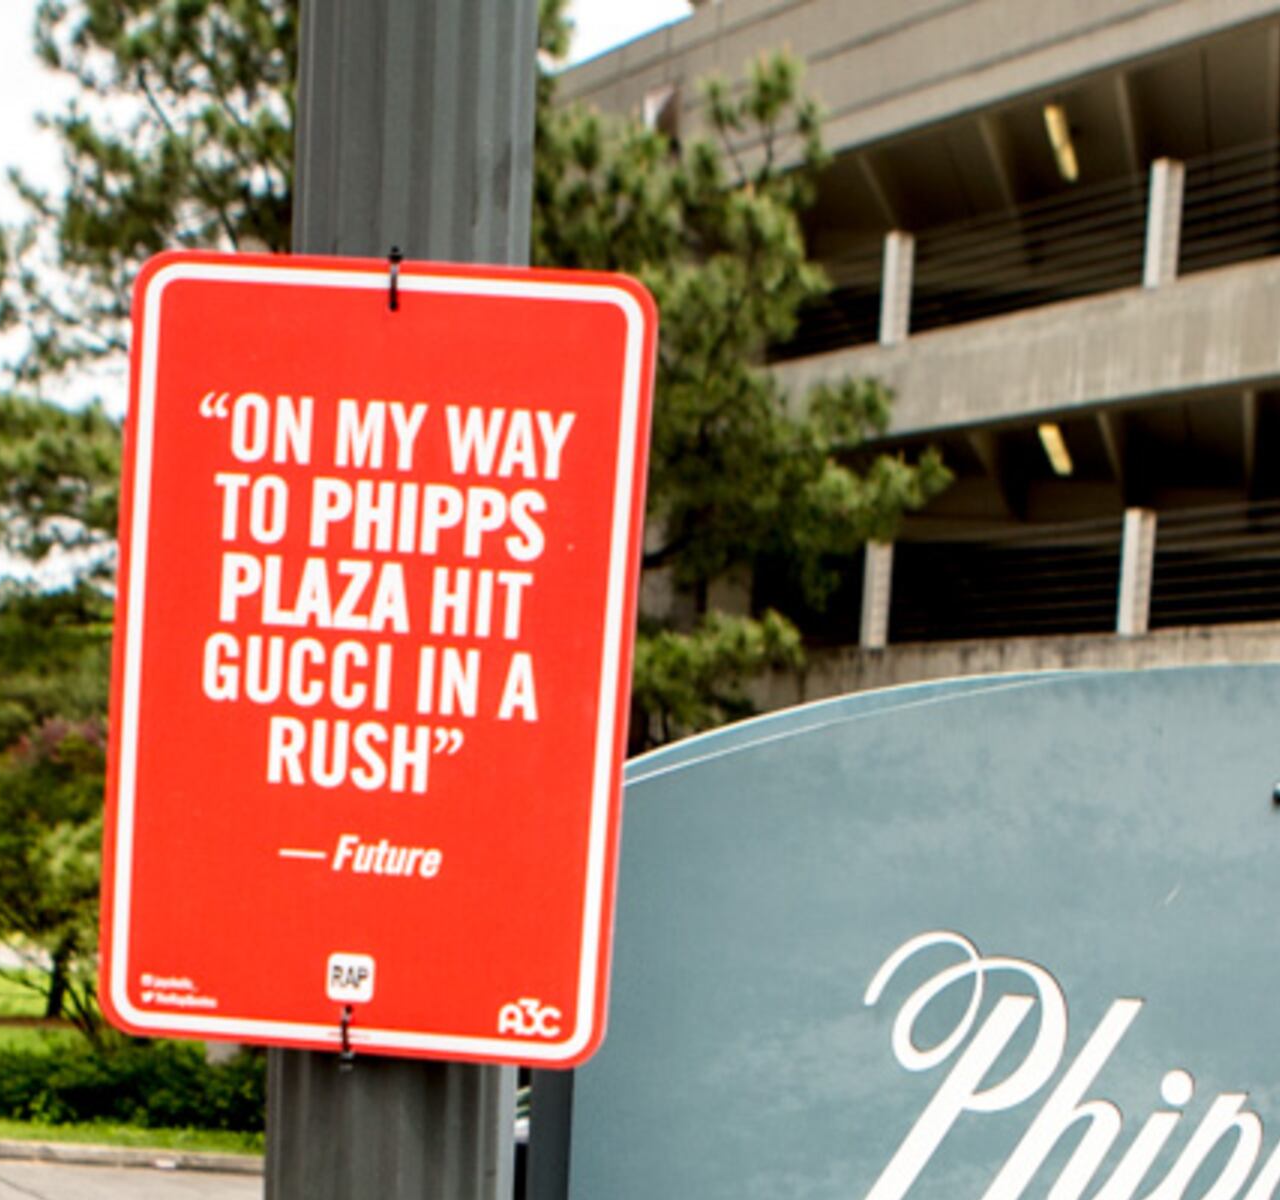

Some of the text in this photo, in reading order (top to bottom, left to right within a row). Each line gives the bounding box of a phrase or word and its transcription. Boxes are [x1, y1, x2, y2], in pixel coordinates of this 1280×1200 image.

[334, 398, 428, 471] MY
[445, 404, 576, 480] WAY
[214, 472, 547, 562] TO PHIPPS
[219, 551, 534, 640] PLAZA HIT
[202, 632, 538, 722] GUCCI IN A
[332, 834, 443, 878] Future
[331, 965, 368, 989] RAP
[497, 997, 562, 1038] A3C
